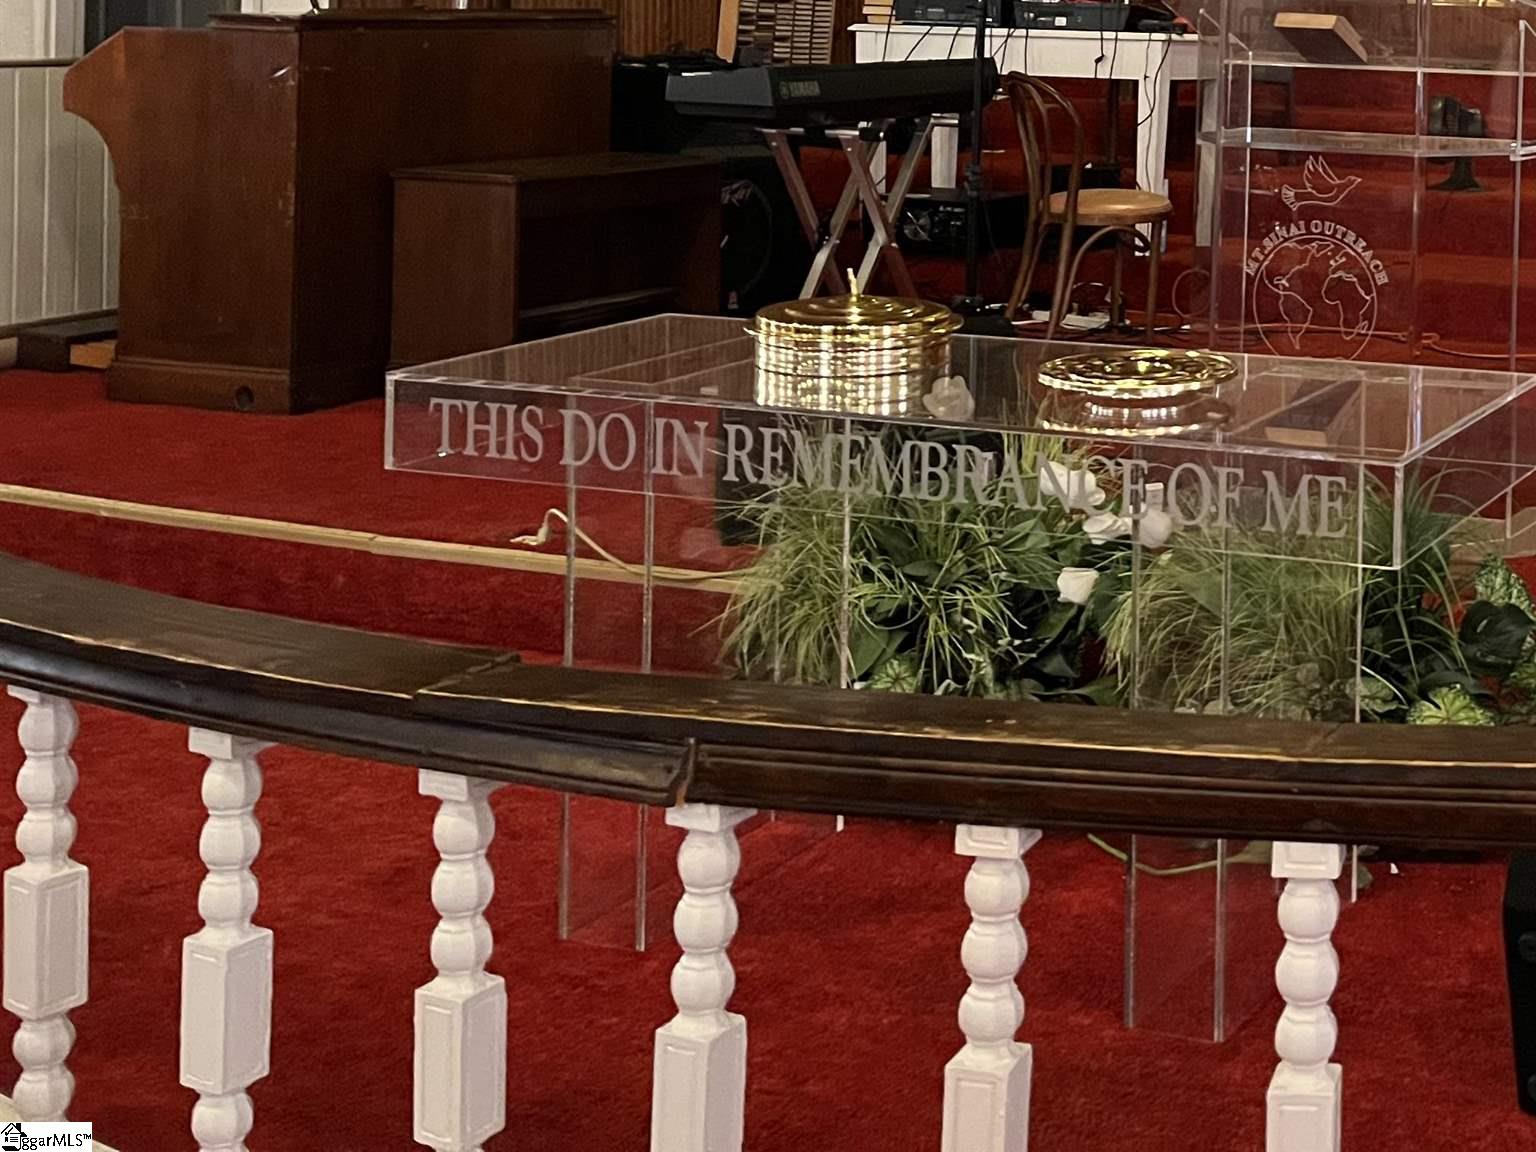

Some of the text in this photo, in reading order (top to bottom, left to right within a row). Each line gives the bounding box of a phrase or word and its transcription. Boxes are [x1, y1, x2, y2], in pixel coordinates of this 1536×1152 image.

[1263, 220, 1306, 252] SINAI
[1310, 219, 1390, 286] OUTREACH
[430, 396, 1347, 539] THIS DO IN REMEMBRANCE OF ME
